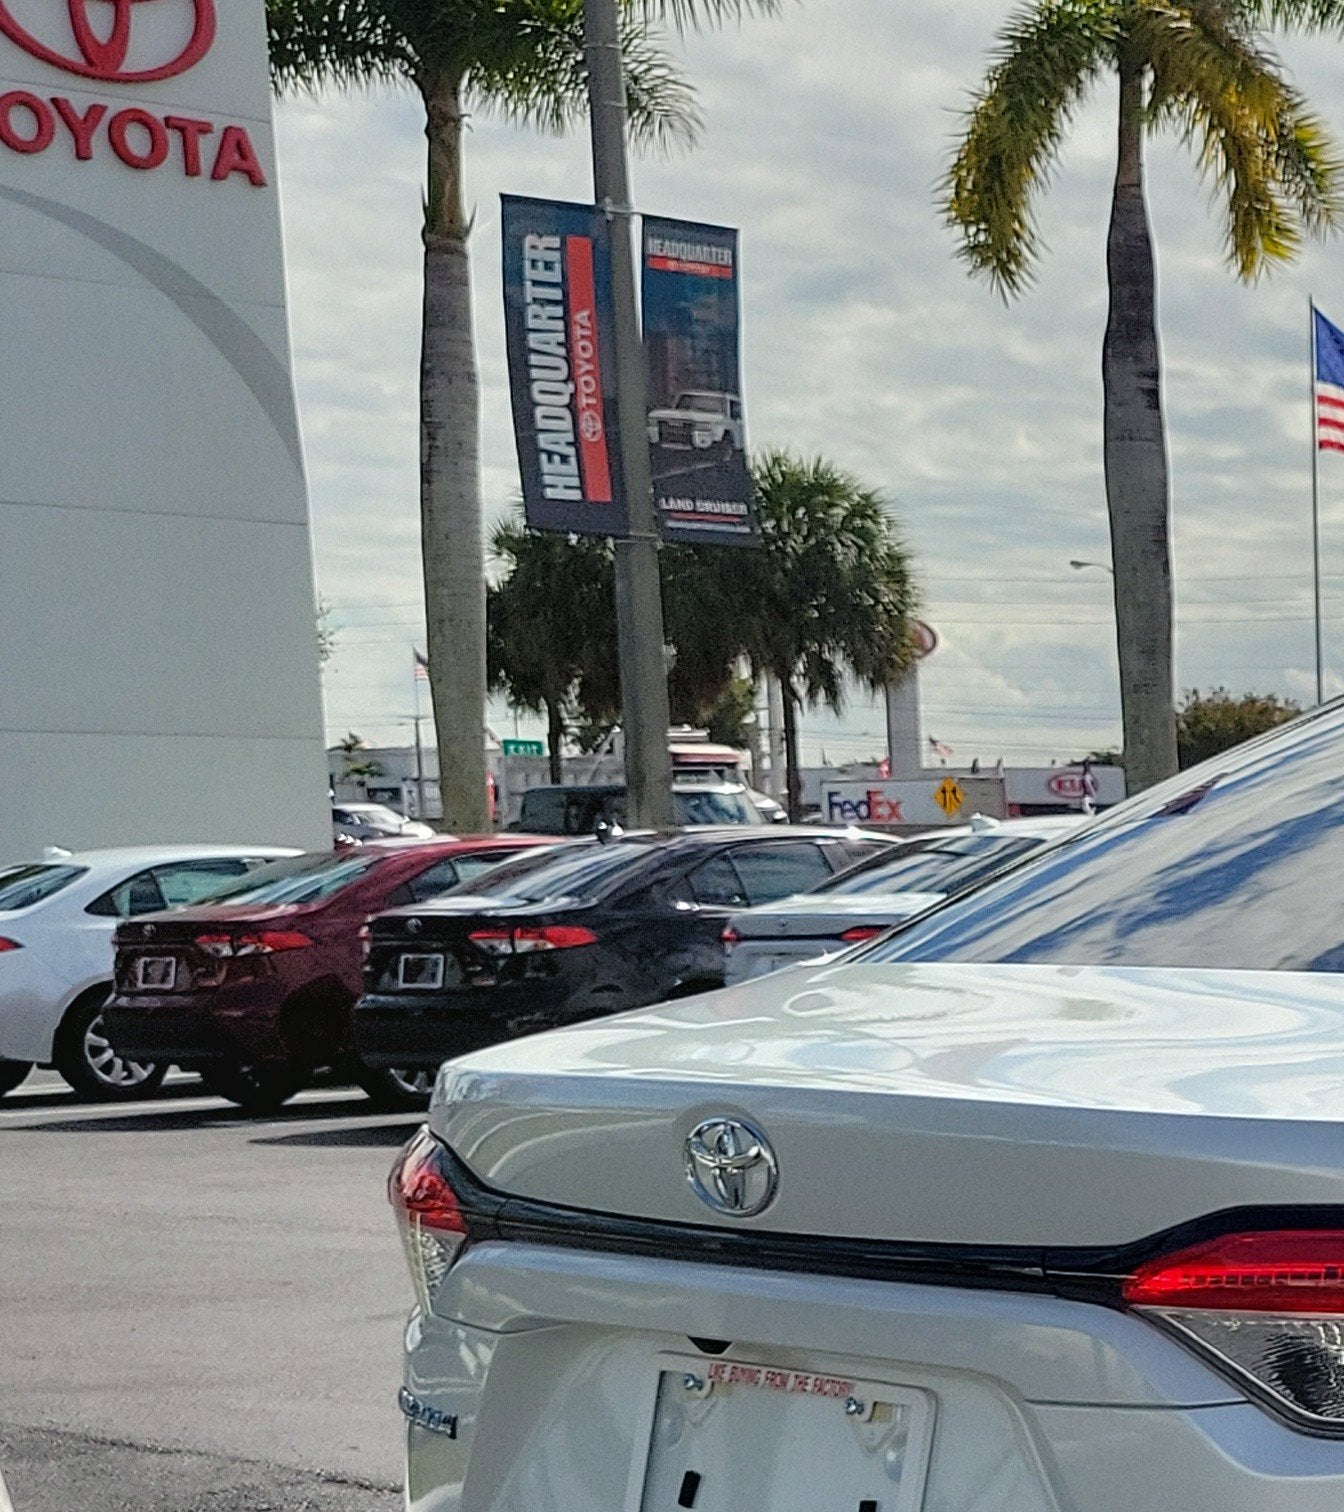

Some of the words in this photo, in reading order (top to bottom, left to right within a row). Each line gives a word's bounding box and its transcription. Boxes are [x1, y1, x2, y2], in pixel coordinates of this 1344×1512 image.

[523, 232, 585, 501] HEADQUARTER
[569, 308, 599, 408] TOYOTA
[826, 787, 902, 822] FedEx
